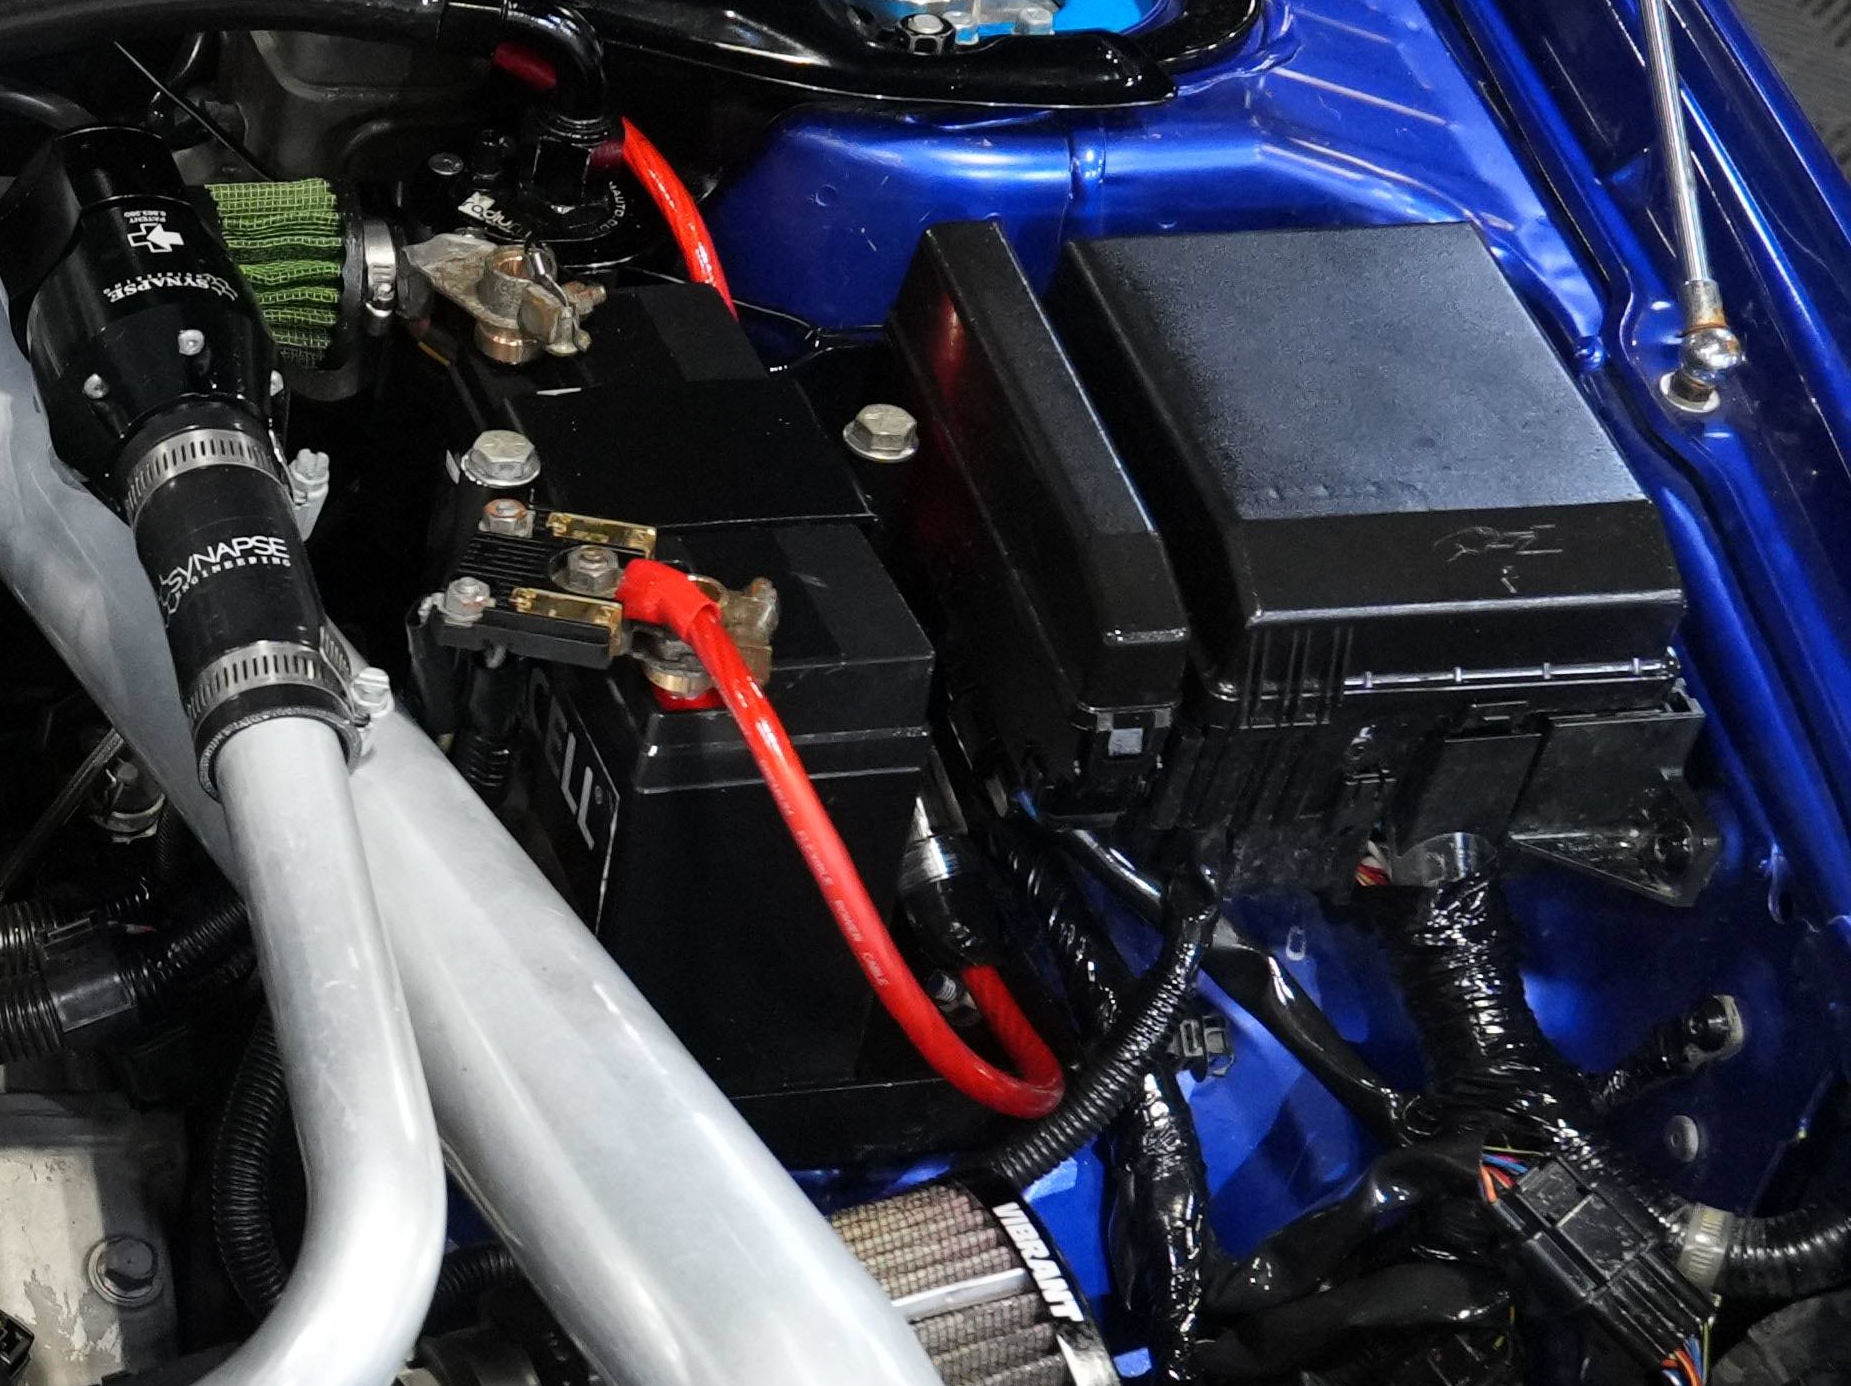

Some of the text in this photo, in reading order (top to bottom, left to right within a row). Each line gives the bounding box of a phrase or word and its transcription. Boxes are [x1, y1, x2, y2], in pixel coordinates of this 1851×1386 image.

[107, 275, 210, 303] SYNAPSE
[168, 535, 291, 594] SYNAPSE
[992, 1201, 1084, 1323] VIBRANT
